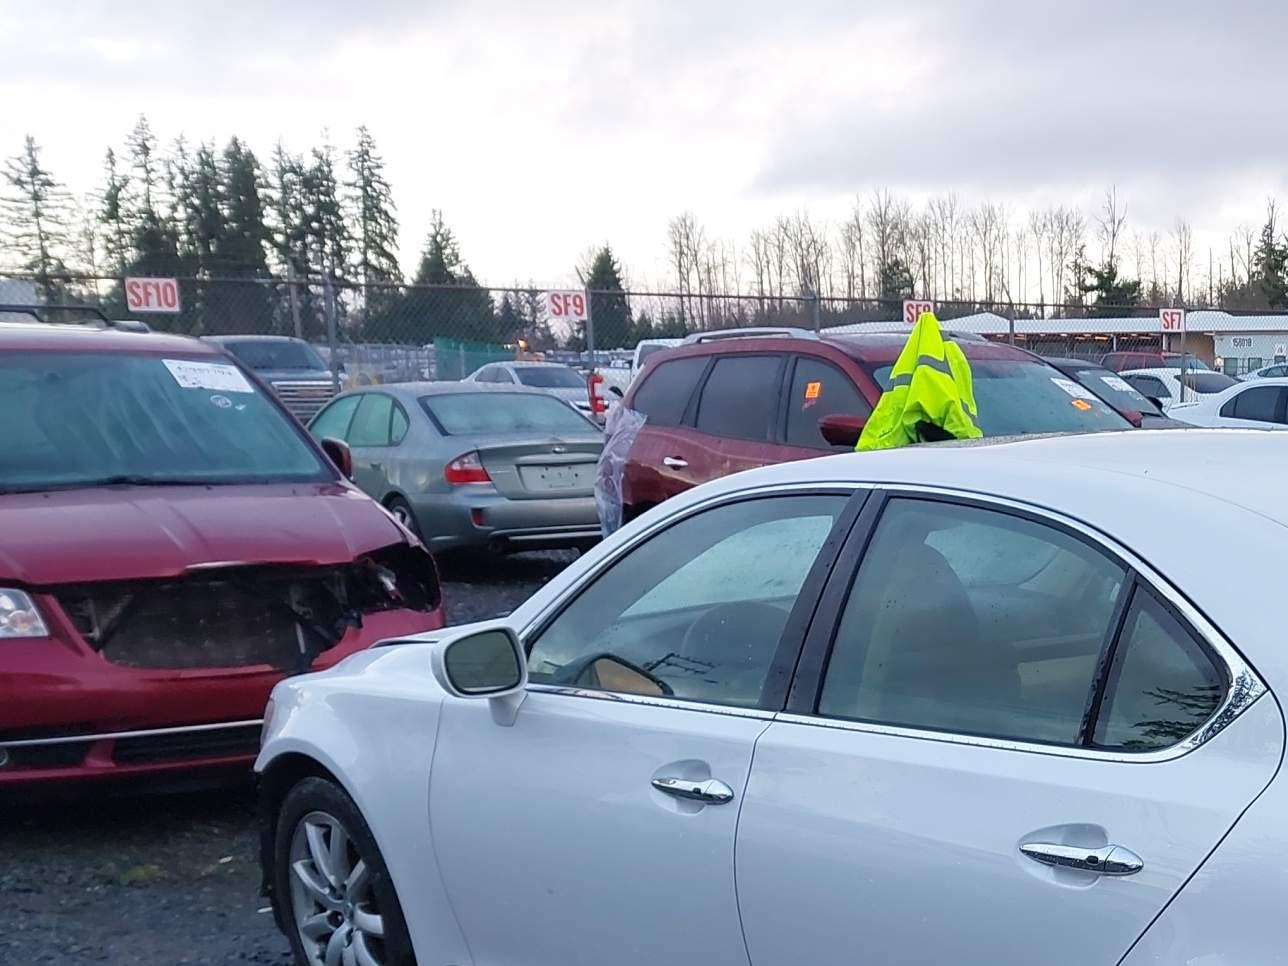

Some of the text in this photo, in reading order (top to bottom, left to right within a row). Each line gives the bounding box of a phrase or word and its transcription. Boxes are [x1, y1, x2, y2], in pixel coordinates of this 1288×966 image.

[128, 281, 176, 307] SF10
[550, 293, 584, 316] SF9
[1162, 311, 1182, 330] SF7
